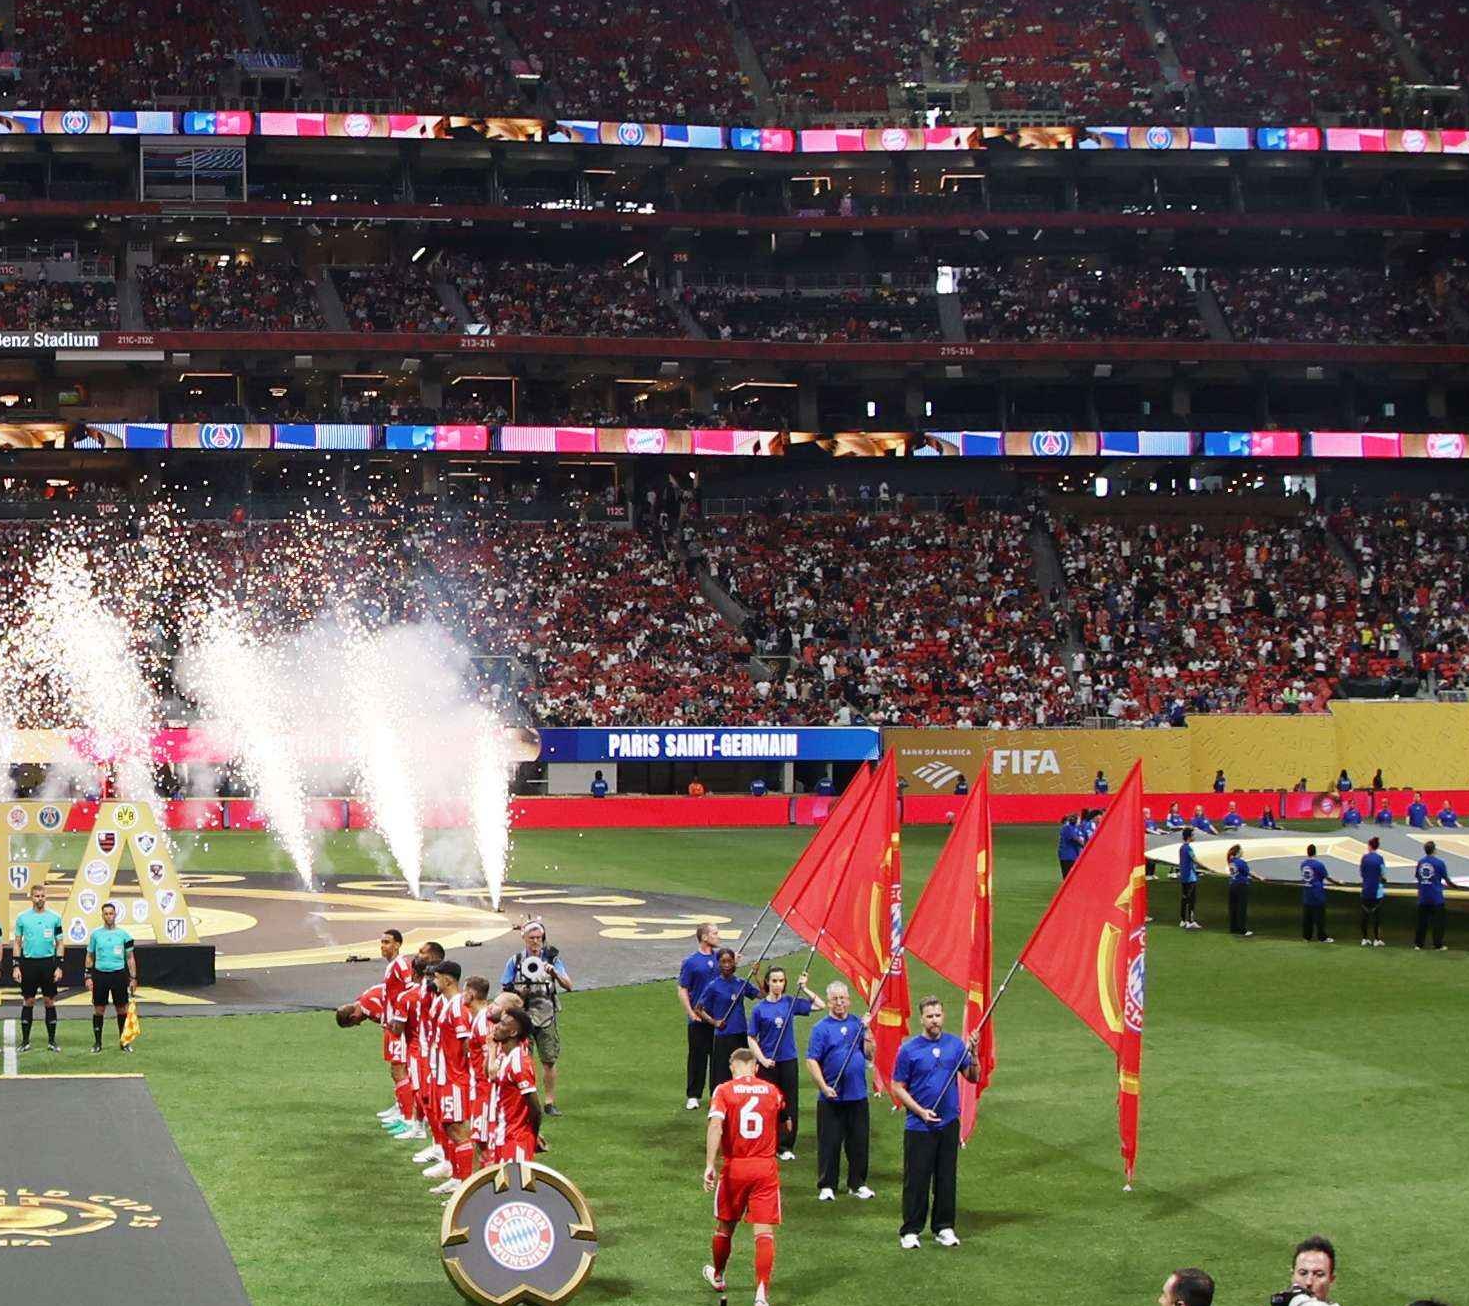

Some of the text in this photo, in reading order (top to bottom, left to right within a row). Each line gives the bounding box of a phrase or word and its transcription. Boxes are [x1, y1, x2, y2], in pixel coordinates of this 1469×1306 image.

[50, 331, 99, 348] Stadium
[608, 733, 798, 758] PARIS SAINT-GERMAIN
[992, 749, 1061, 775] FIFA
[739, 1096, 763, 1140] 6
[502, 1205, 548, 1232] BAYERN
[492, 1241, 550, 1266] MÜNCHEN
